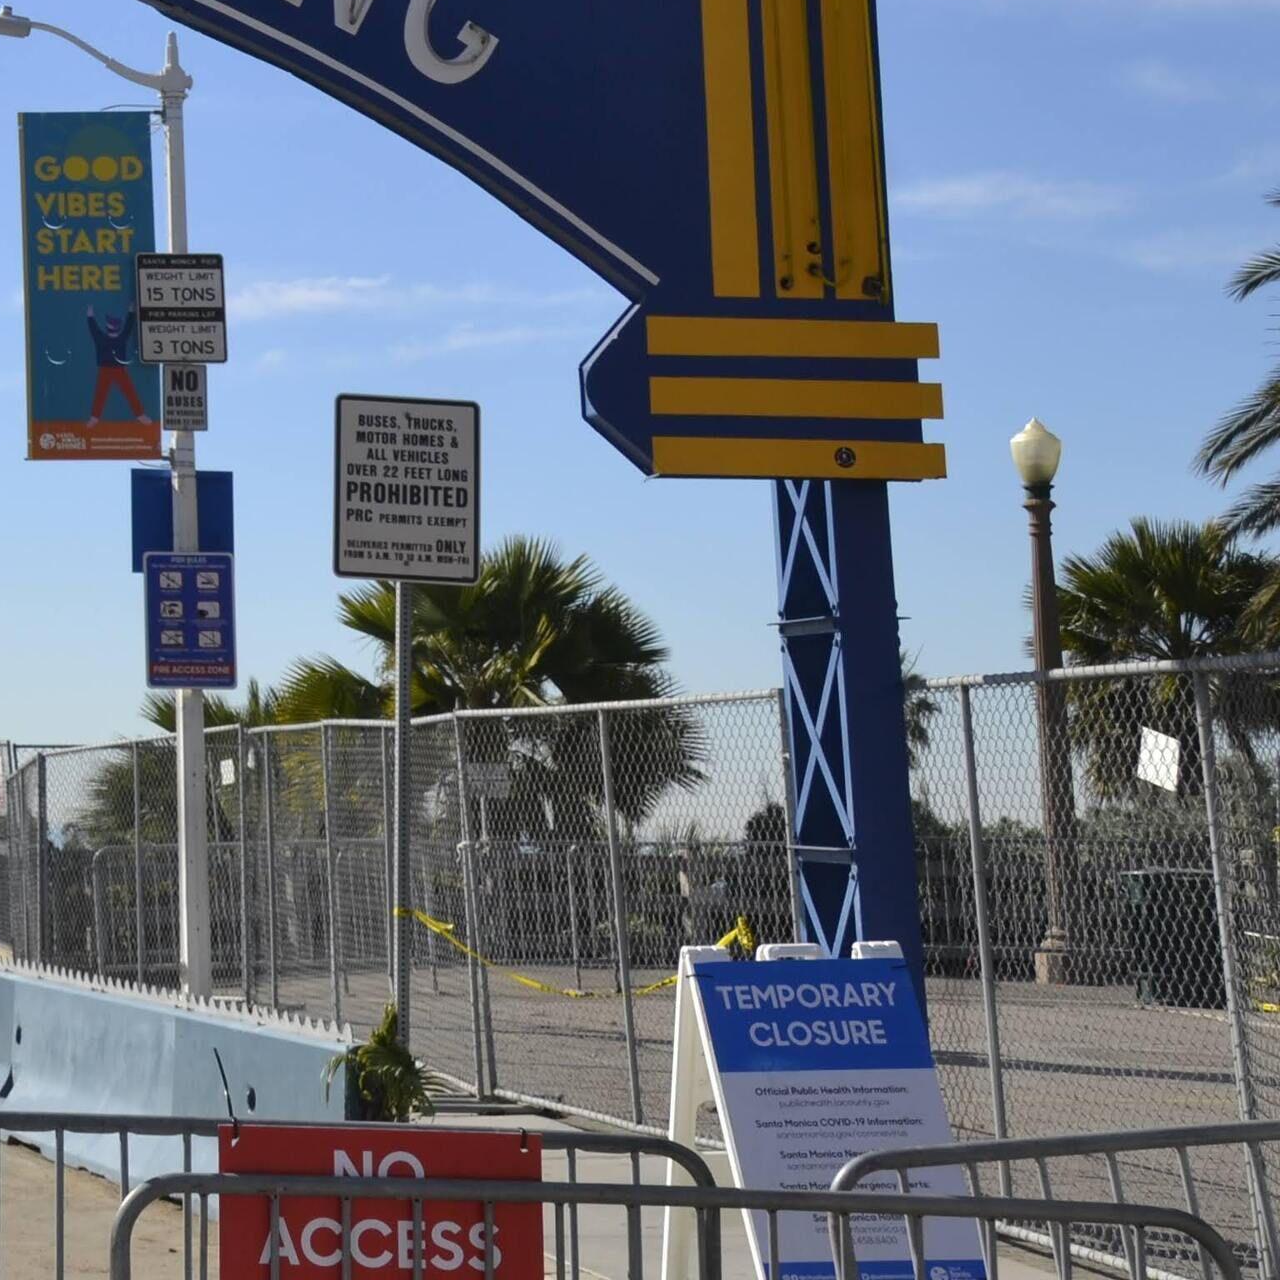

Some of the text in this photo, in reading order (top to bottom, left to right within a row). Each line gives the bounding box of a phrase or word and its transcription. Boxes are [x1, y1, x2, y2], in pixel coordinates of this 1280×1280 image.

[34, 156, 144, 181] GOOD
[35, 192, 125, 217] VIBES
[36, 228, 134, 254] START
[38, 264, 122, 291] HERE
[145, 272, 215, 281] WEIGHT LIMIT
[147, 287, 216, 302] 15 TONS
[148, 325, 216, 334] WEIGHT LIMIT
[153, 340, 215, 354] 3 TONS
[171, 370, 199, 392] NO
[167, 396, 203, 407] BUSES
[358, 414, 457, 433] BUSES, TRUCKS,
[356, 431, 459, 449] MOTOR HOMES &
[366, 448, 449, 465] ALL VEHICLES
[347, 463, 468, 482] OVER 22 FEET LONG
[346, 481, 469, 508] PROHIBITED
[346, 508, 468, 528] PRC PERMITS EXEMPT
[436, 539, 466, 554] ONLY
[715, 982, 896, 1010] TEMPORARY
[749, 1020, 887, 1047] CLOSURE
[755, 1087, 789, 1096] Official
[791, 1086, 820, 1095] Public
[821, 1085, 851, 1095] Health
[755, 1119, 783, 1128] Santa
[784, 1119, 818, 1128] Monica
[820, 1117, 865, 1127] COVID-19
[780, 1150, 807, 1159] Santa
[809, 1150, 843, 1159] Monica
[809, 1182, 831, 1191] Moni
[259, 1216, 502, 1271] ACCESS
